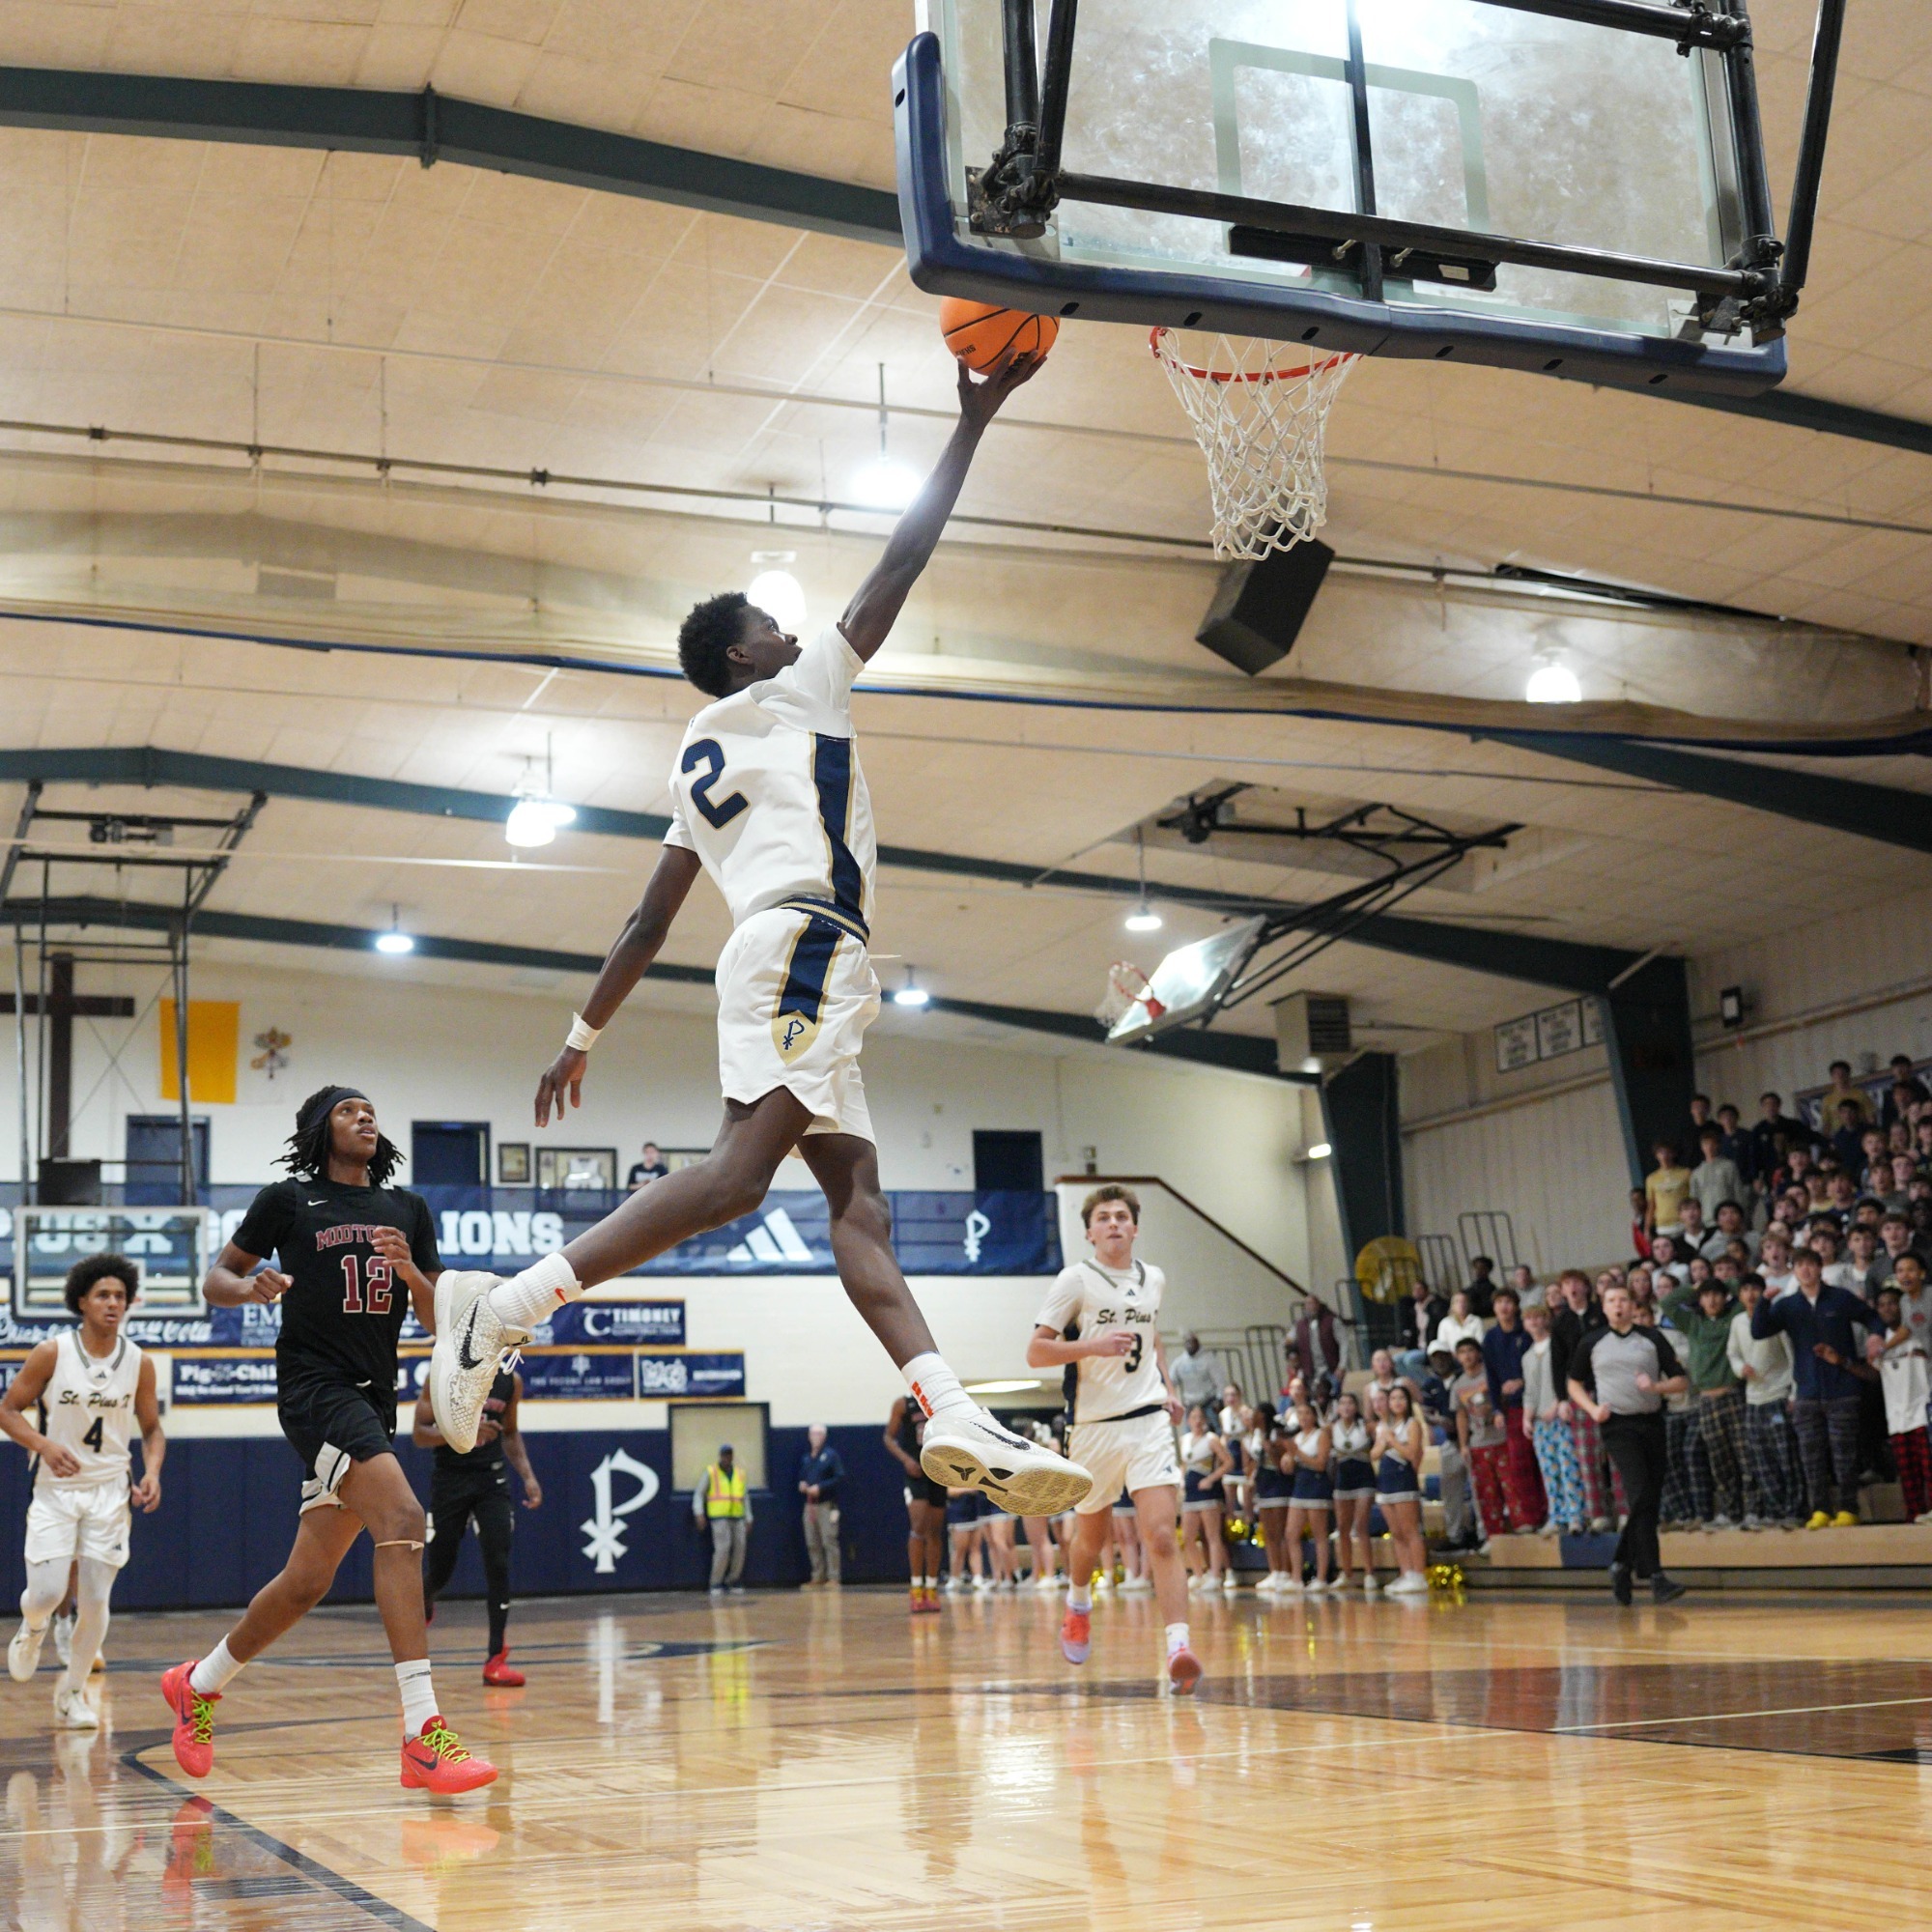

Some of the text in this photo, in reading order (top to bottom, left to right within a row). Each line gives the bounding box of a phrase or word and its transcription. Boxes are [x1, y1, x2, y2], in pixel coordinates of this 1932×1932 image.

[680, 736, 751, 831] 2
[316, 1224, 406, 1251] MIDTO
[437, 1210, 564, 1255] IONS
[341, 1255, 393, 1314] 12
[1096, 1308, 1151, 1324] St. Pius
[1124, 1333, 1142, 1374] 3
[59, 1391, 80, 1406] St.
[88, 1392, 118, 1408] Pius
[83, 1416, 103, 1453] 4
